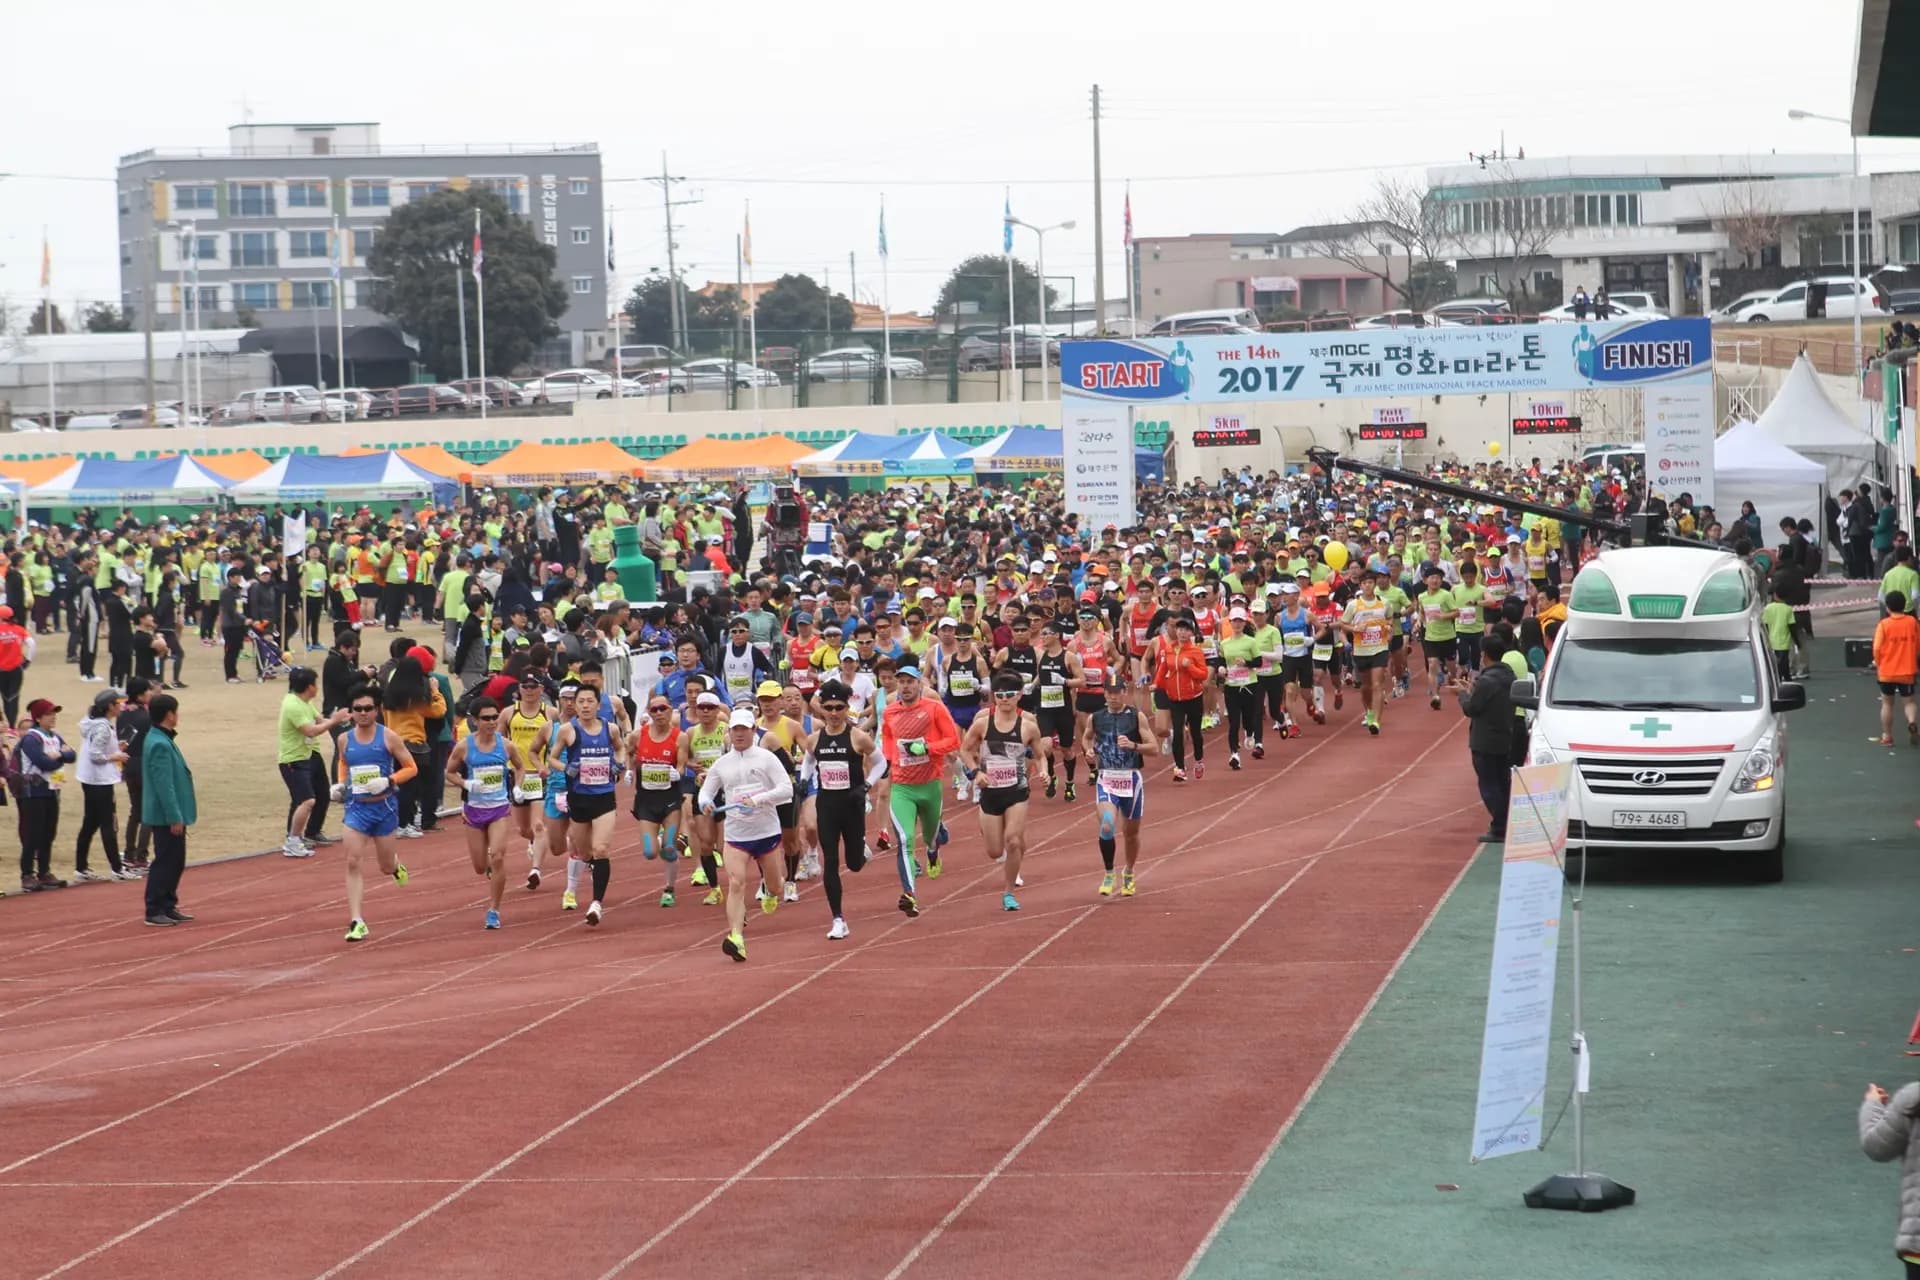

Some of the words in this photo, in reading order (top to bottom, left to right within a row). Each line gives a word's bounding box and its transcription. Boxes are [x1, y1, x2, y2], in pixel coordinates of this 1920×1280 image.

[1216, 351, 1241, 361] THE
[1246, 345, 1281, 360] 14th
[1603, 341, 1692, 370] FINISH
[1320, 361, 1381, 394] 국제
[1384, 335, 1546, 376] 평화마라톤
[1081, 361, 1162, 389] START
[1218, 365, 1304, 394] 2017
[1354, 384, 1372, 393] JEJU
[1374, 383, 1395, 392] MBC
[1397, 381, 1464, 392] INTERNATIONAL
[1466, 380, 1493, 389] PEACE
[1496, 378, 1547, 388] MARATHON
[1532, 404, 1563, 416] 10km
[1215, 417, 1240, 429] 5km
[1619, 813, 1643, 825] 79수
[1648, 814, 1679, 825] 4648
